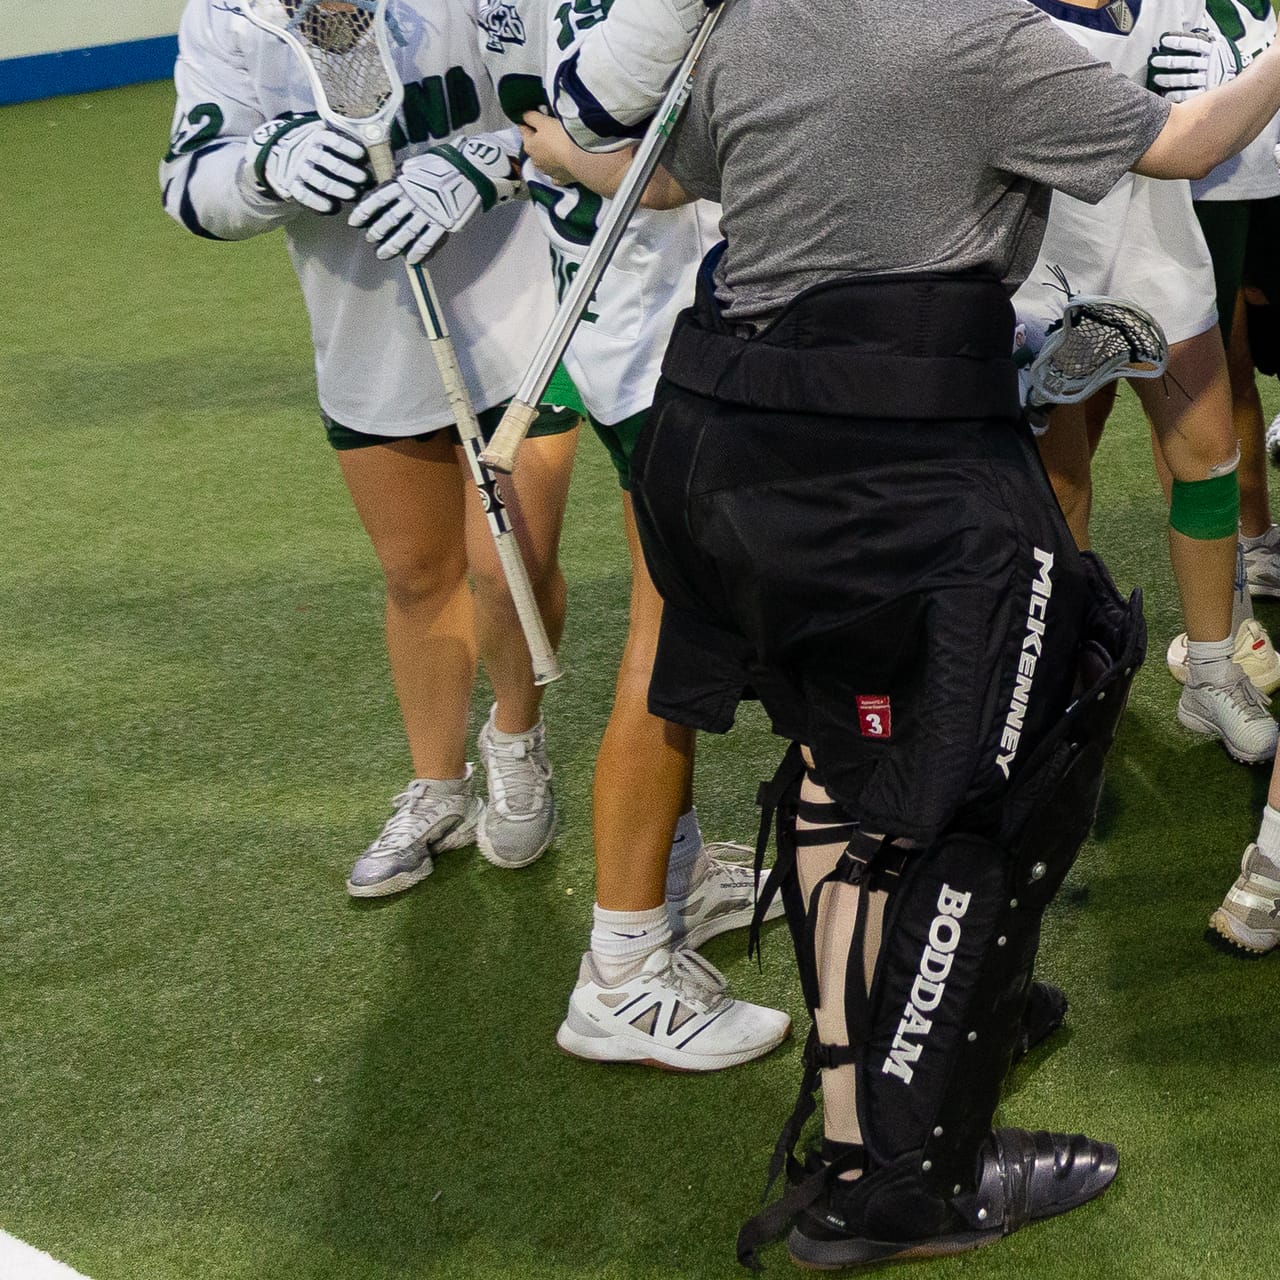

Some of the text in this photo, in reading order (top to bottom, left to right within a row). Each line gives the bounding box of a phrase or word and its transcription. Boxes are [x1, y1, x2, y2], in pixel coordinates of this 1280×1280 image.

[866, 713, 883, 735] 3
[995, 547, 1055, 781] MCKENNEY
[882, 883, 972, 1085] BODDAM
